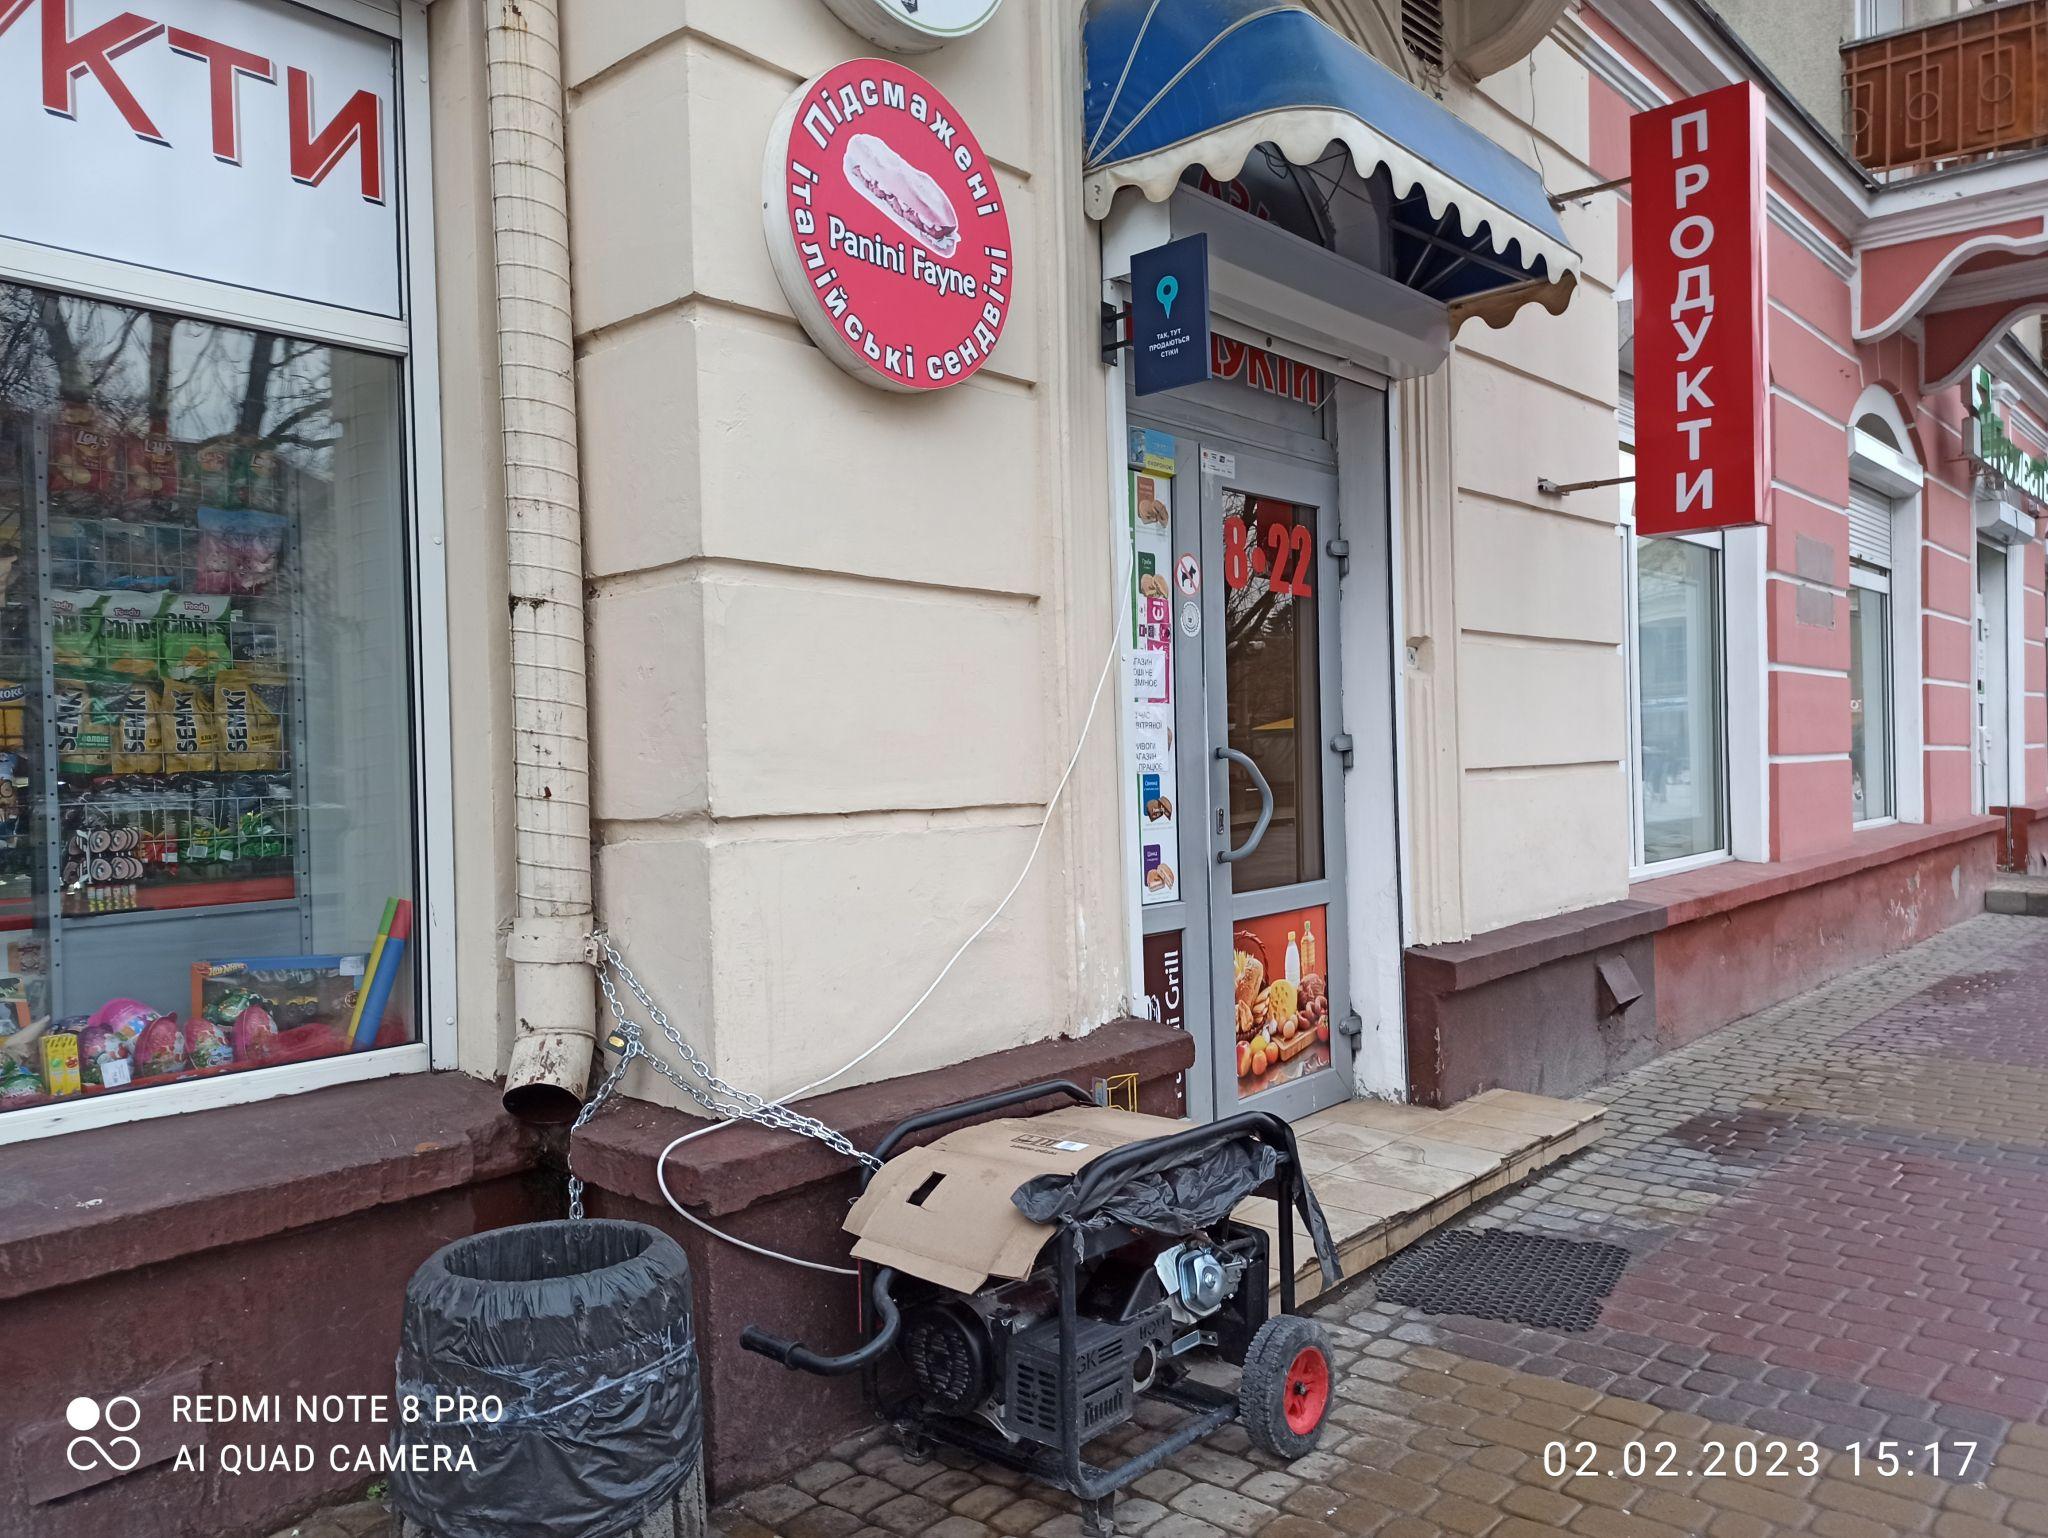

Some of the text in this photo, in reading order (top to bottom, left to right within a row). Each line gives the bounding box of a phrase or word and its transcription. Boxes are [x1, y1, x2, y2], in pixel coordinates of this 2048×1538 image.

[0, 0, 386, 207] КТИ
[801, 78, 999, 217] Підсмажені
[790, 159, 1008, 381] італійські сендвічі
[827, 212, 977, 299] Panini Fayne
[1149, 335, 1190, 352] ПРОДАЮТЬСЯ
[1156, 328, 1181, 340] ТАК, ТУТ
[1669, 109, 1715, 513] ПРОДУКТИ
[1160, 347, 1179, 358] СТІКИ
[184, 600, 209, 613] Foody
[1164, 950, 1179, 1010] Grill
